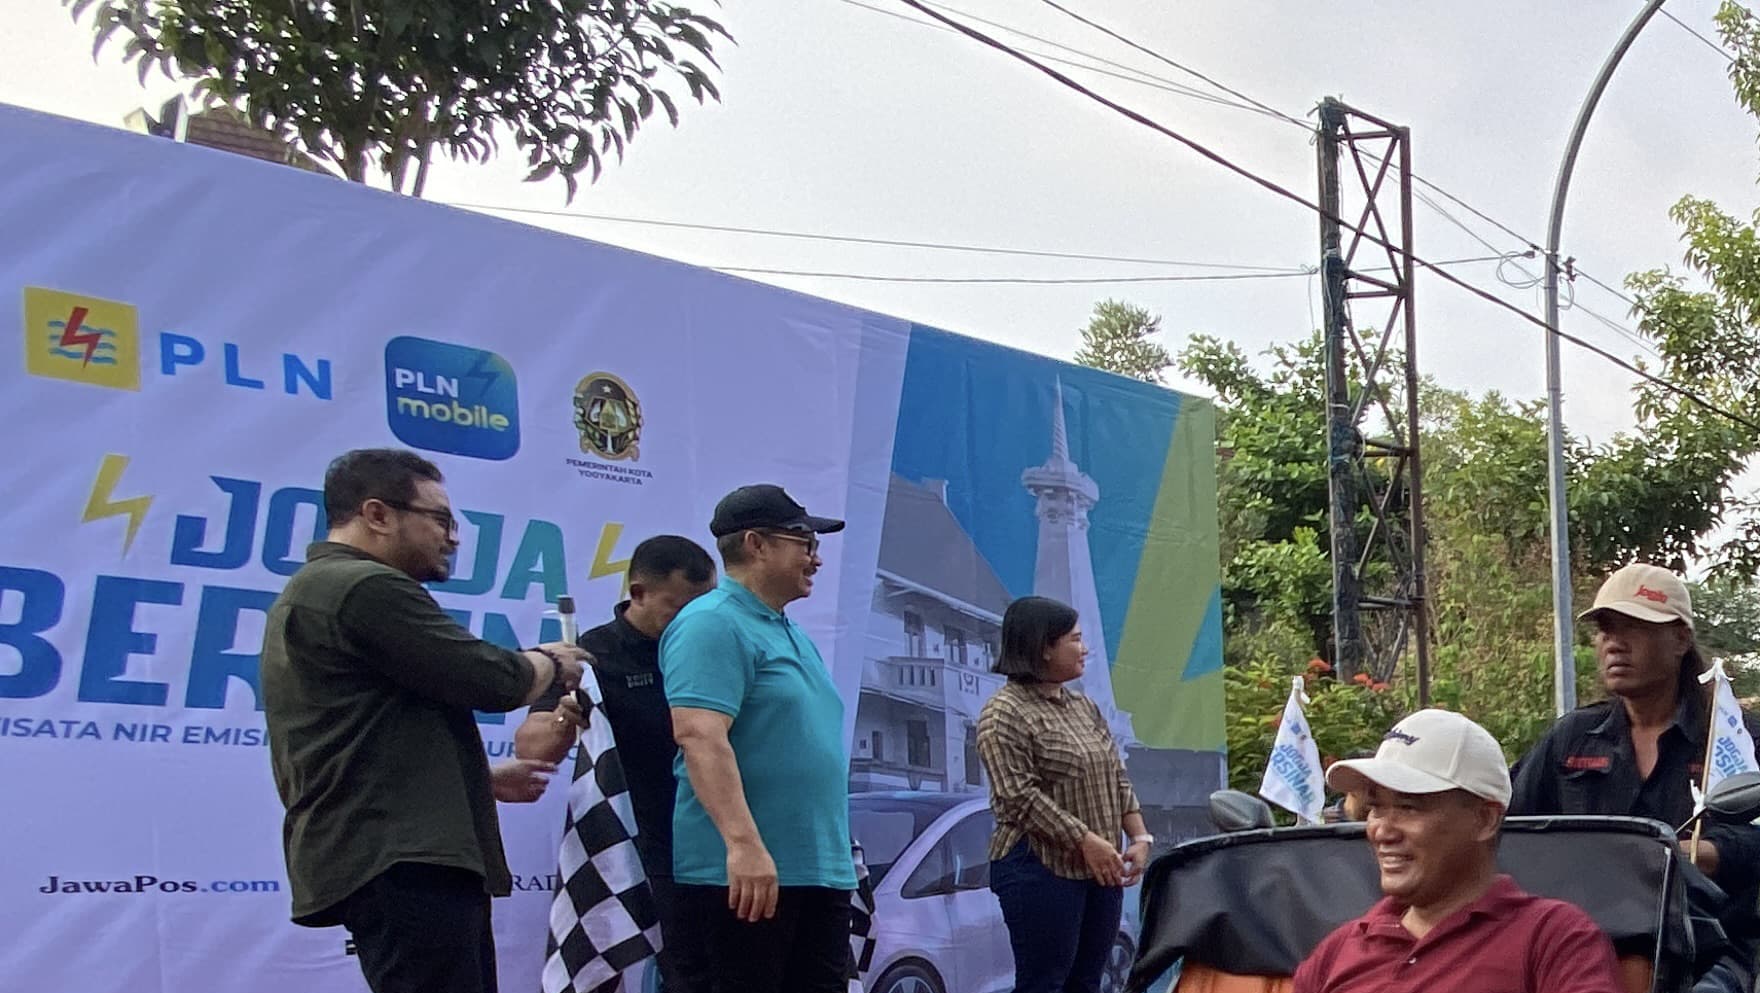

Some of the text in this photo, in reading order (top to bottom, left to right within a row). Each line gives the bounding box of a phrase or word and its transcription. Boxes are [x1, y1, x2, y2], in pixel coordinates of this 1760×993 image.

[160, 332, 332, 400] PLN
[394, 367, 460, 398] PLN
[397, 397, 510, 432] mobile
[565, 458, 654, 479] PEMERINTAH KOTA
[578, 469, 643, 486] YOGYAKARTA
[170, 476, 568, 605] JOJA
[0, 717, 102, 740] ISATA
[112, 722, 172, 743] NIR
[39, 875, 280, 894] JawaPos.com
